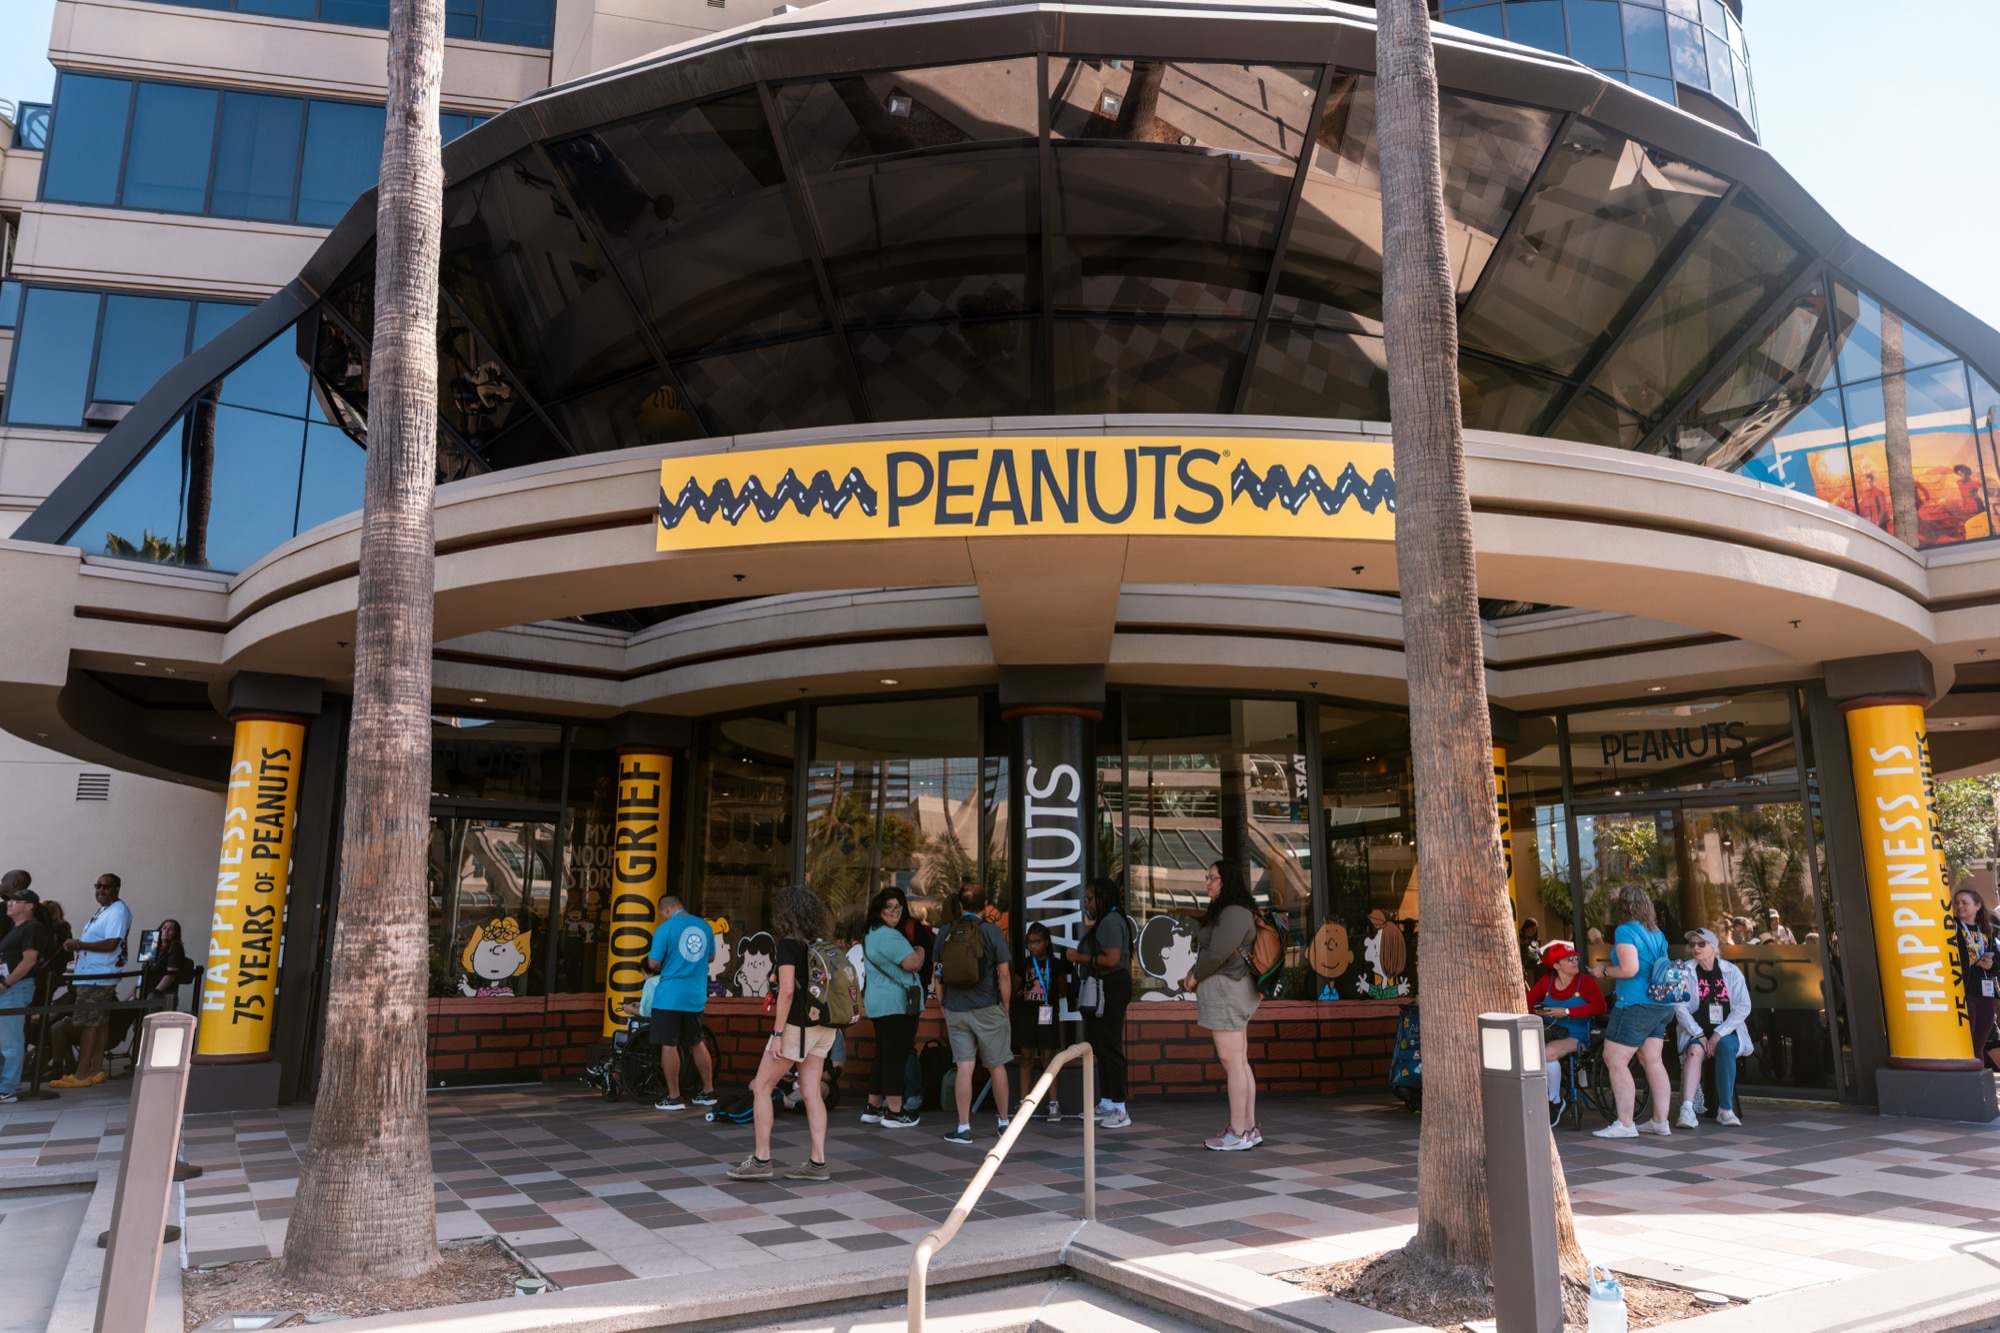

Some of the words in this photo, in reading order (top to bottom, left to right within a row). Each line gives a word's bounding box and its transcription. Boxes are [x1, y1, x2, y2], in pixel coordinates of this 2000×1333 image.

[1600, 720, 1749, 765] PEANUTS
[1869, 744, 1914, 777] IS
[251, 747, 292, 860] PEANUTS
[584, 823, 611, 845] MY
[615, 762, 660, 884] GRIEF
[202, 805, 248, 1011] HAPPINESS
[228, 759, 252, 789] IS
[255, 871, 275, 893] OF
[567, 867, 614, 889] STOR
[1025, 763, 1083, 1022] ANUTS
[1877, 793, 1949, 1012] HAPPINESS
[237, 905, 275, 987] YEARS
[232, 996, 266, 1025] 75
